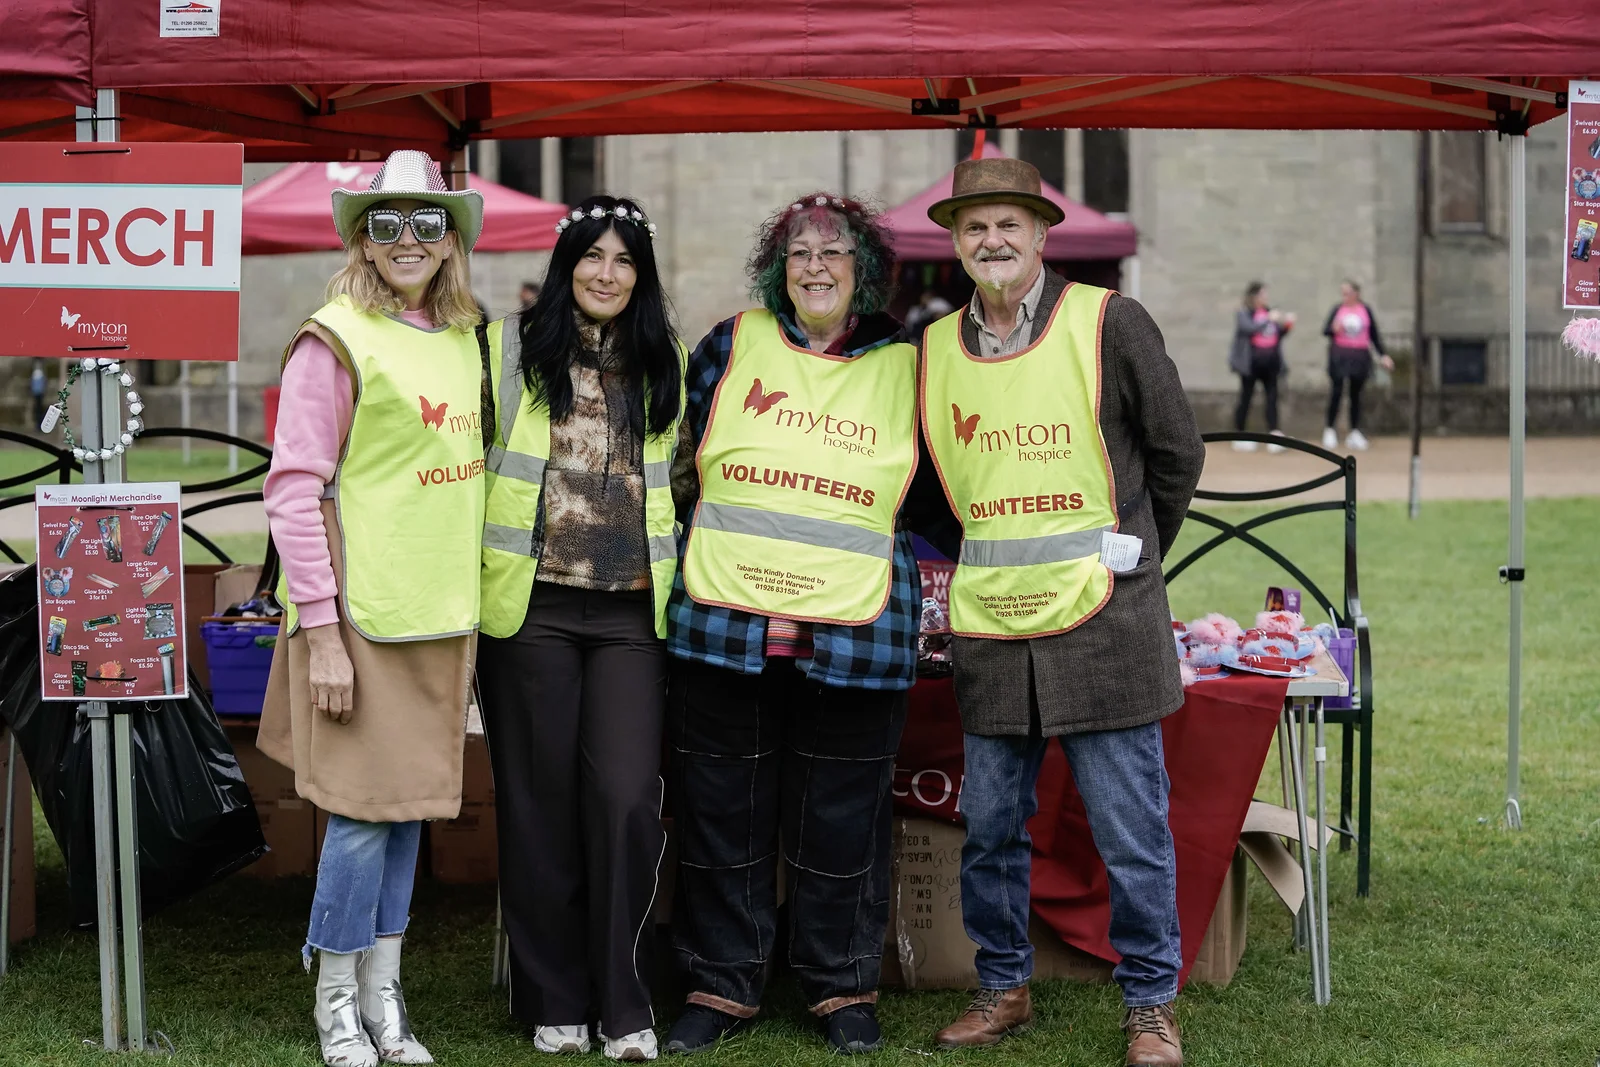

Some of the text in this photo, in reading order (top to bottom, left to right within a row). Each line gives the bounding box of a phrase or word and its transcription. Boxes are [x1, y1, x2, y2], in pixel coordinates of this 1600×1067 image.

[0, 207, 214, 267] MERCH
[77, 322, 127, 338] myton
[101, 334, 127, 343] hospice
[775, 408, 877, 446] myton
[823, 434, 875, 458] hospice
[979, 423, 1071, 457] myton
[1018, 448, 1072, 464] hospice
[721, 463, 876, 507] VOLUNTEERS
[71, 493, 162, 504] Moonlight Merchandise
[969, 492, 1084, 520] OLUNTEERS
[736, 563, 826, 586] Tabards Kindly Donated by
[743, 573, 763, 582] Colan
[764, 576, 775, 584] Ltd
[785, 580, 815, 591] Warwick
[755, 583, 800, 596] 01926 831584
[997, 595, 1017, 603] Kindly
[1018, 591, 1048, 601] Donated
[1019, 599, 1050, 609] Warwick
[1013, 609, 1038, 617] 831584
[910, 918, 932, 929] QTY:
